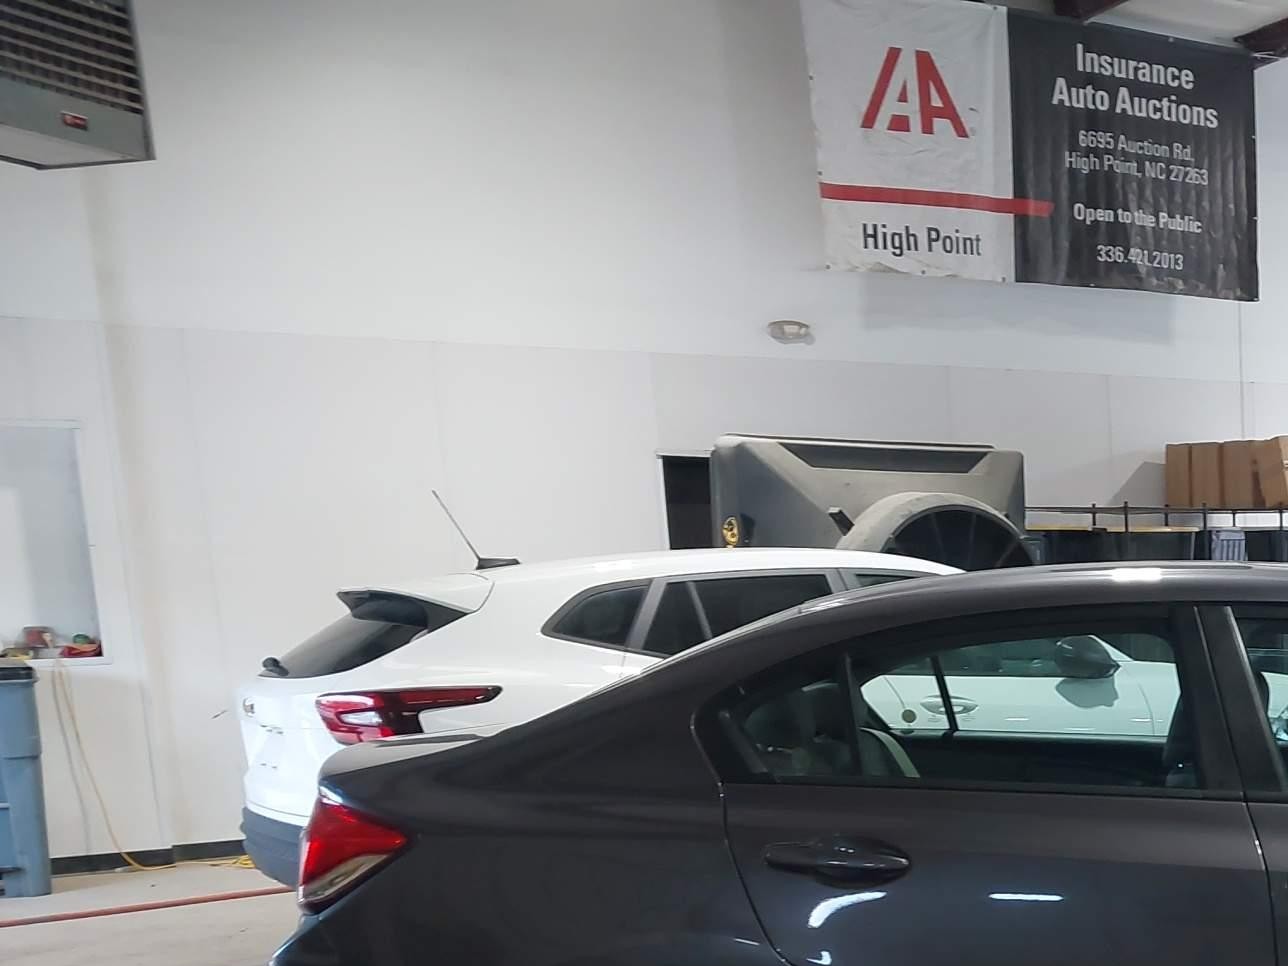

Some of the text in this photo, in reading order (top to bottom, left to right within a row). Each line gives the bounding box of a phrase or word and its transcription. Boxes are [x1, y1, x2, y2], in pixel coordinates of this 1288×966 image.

[1075, 43, 1195, 90] Insurance
[1052, 77, 1219, 128] Auto Auctions
[1078, 130, 1115, 150] 6695
[1117, 134, 1170, 159] Auction
[1064, 151, 1100, 174] High
[1145, 161, 1166, 180] NC
[1169, 164, 1209, 186] 27263
[1073, 203, 1203, 234] Open to the Public
[861, 222, 982, 257] High Point
